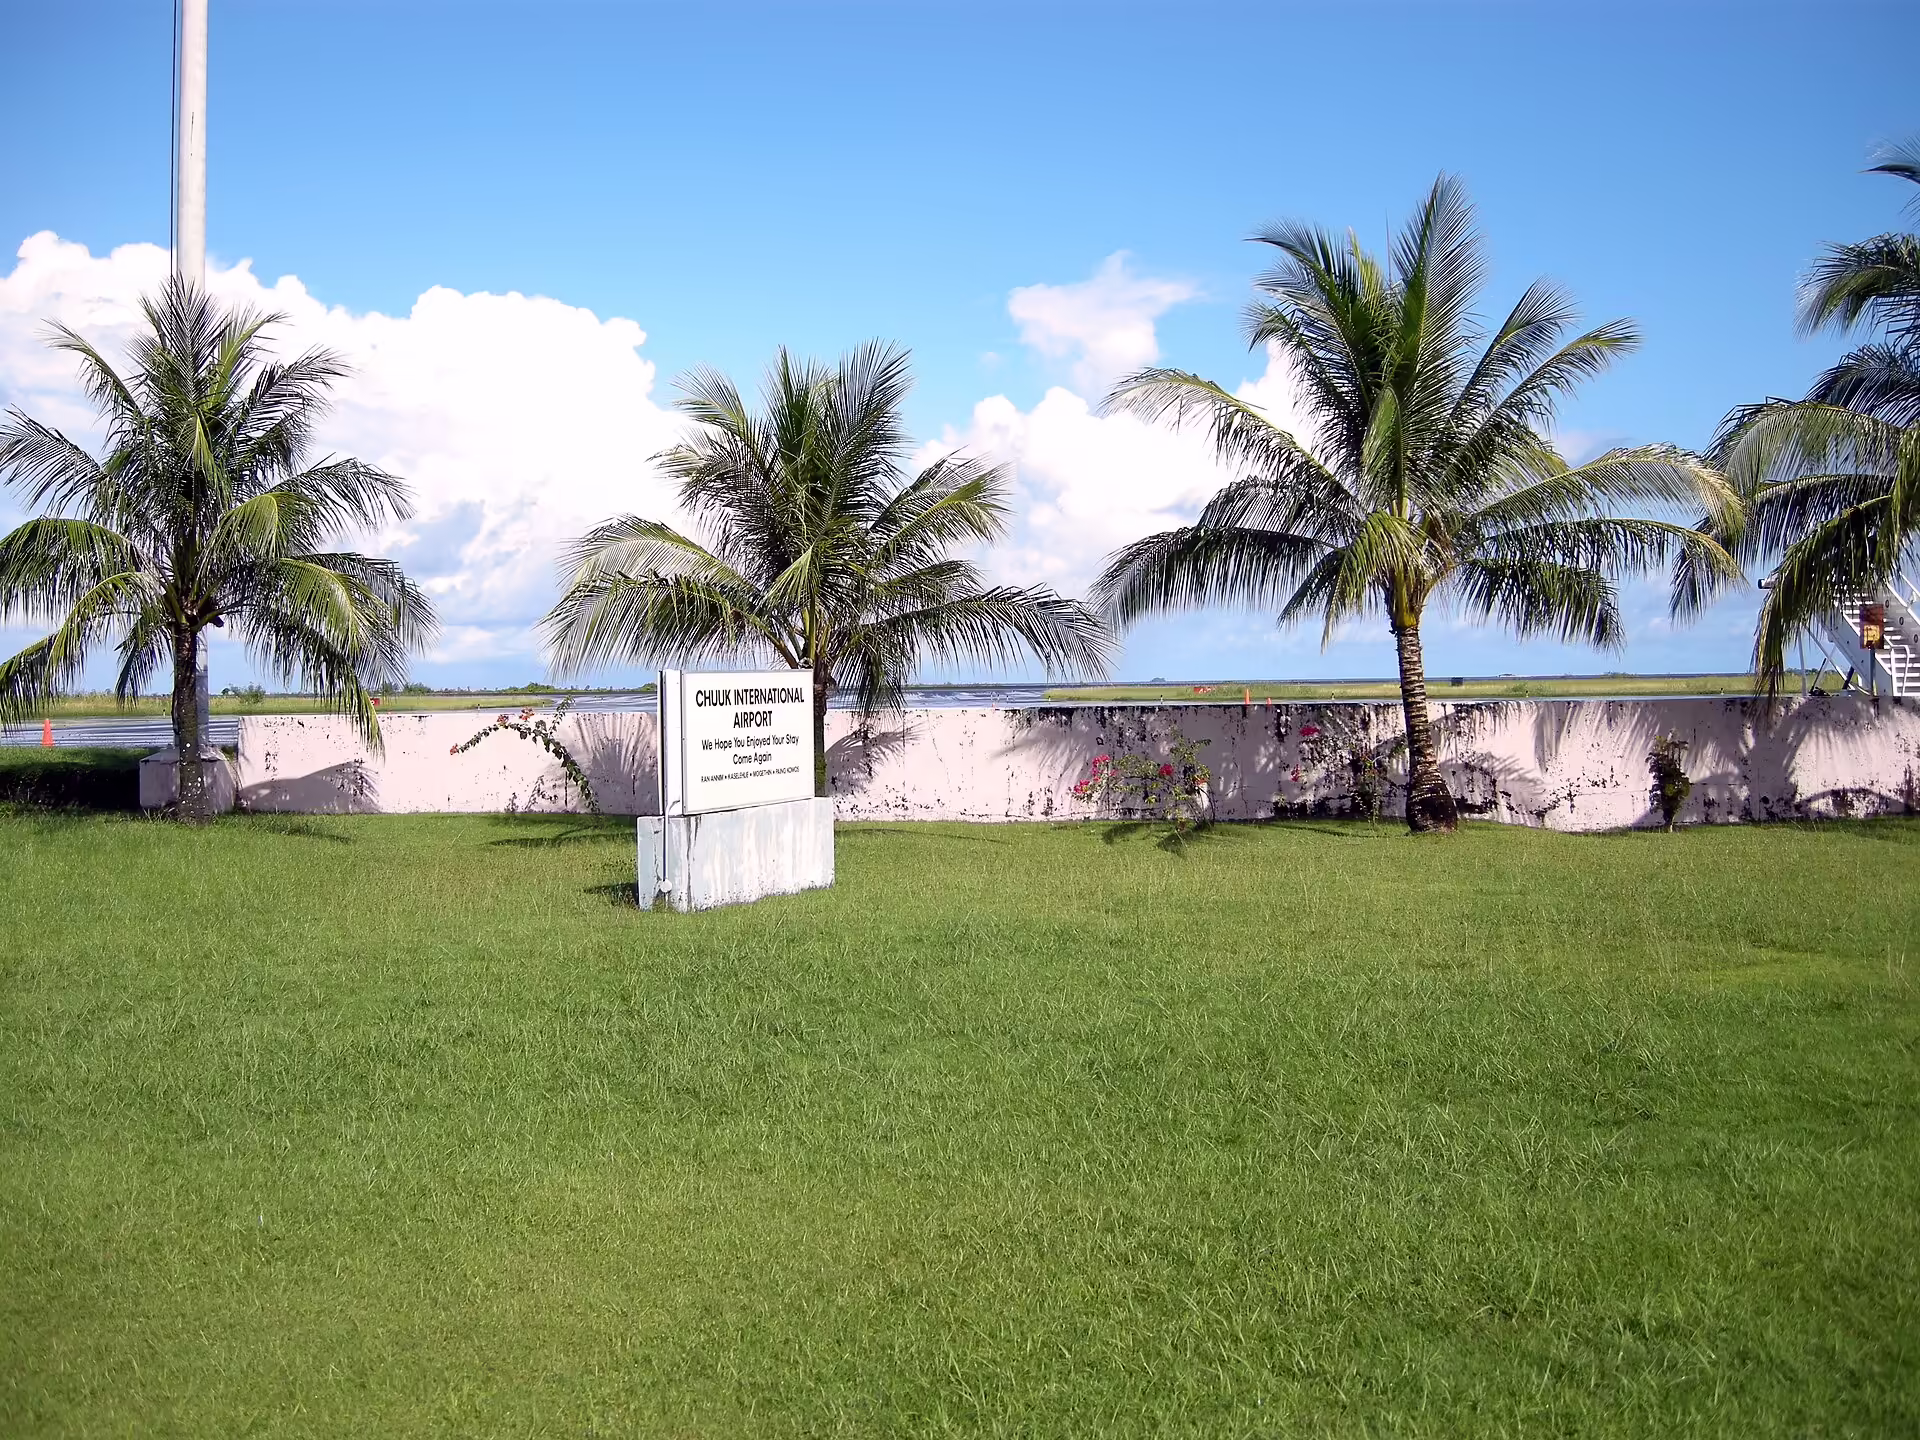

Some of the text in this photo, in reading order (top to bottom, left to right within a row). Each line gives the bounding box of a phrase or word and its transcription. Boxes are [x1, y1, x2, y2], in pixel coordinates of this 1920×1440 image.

[695, 687, 805, 707] CHUUK INTERNATIONAL
[733, 710, 773, 728] AIRPORT
[701, 733, 800, 751] We Hope You Enjoyed Your Stay
[732, 751, 772, 765] Come Again
